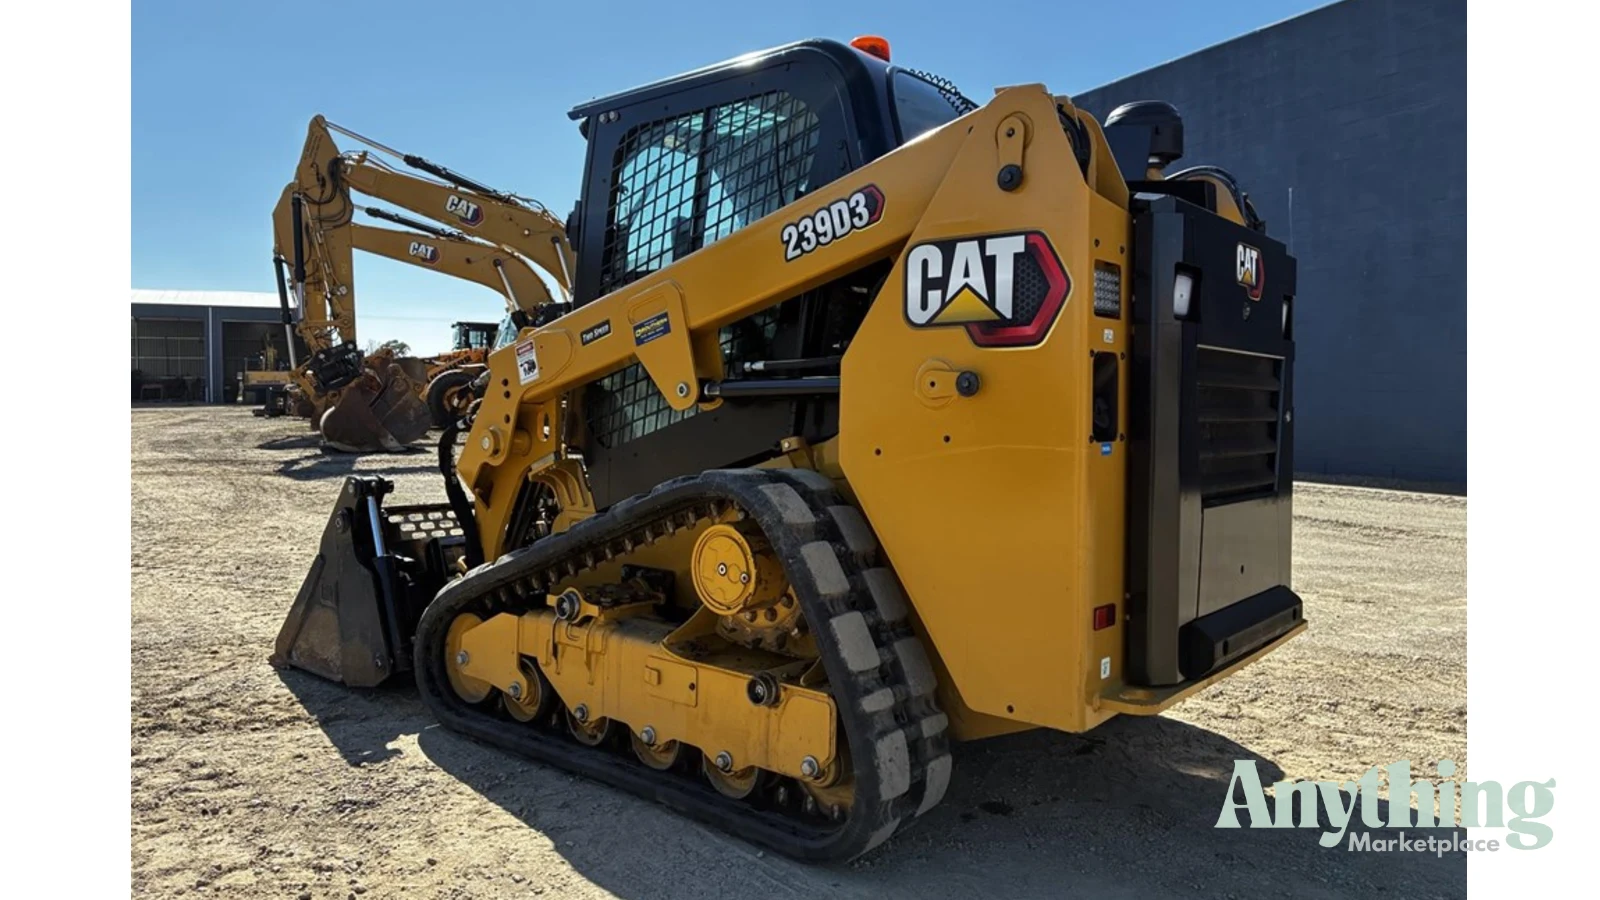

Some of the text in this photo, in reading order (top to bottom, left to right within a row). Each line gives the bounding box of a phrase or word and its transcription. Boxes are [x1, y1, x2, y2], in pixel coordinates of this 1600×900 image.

[445, 194, 479, 220] CAT
[782, 191, 870, 261] 239D3
[408, 241, 435, 260] CAT
[1236, 244, 1258, 287] CAT
[907, 234, 1026, 325] CAT
